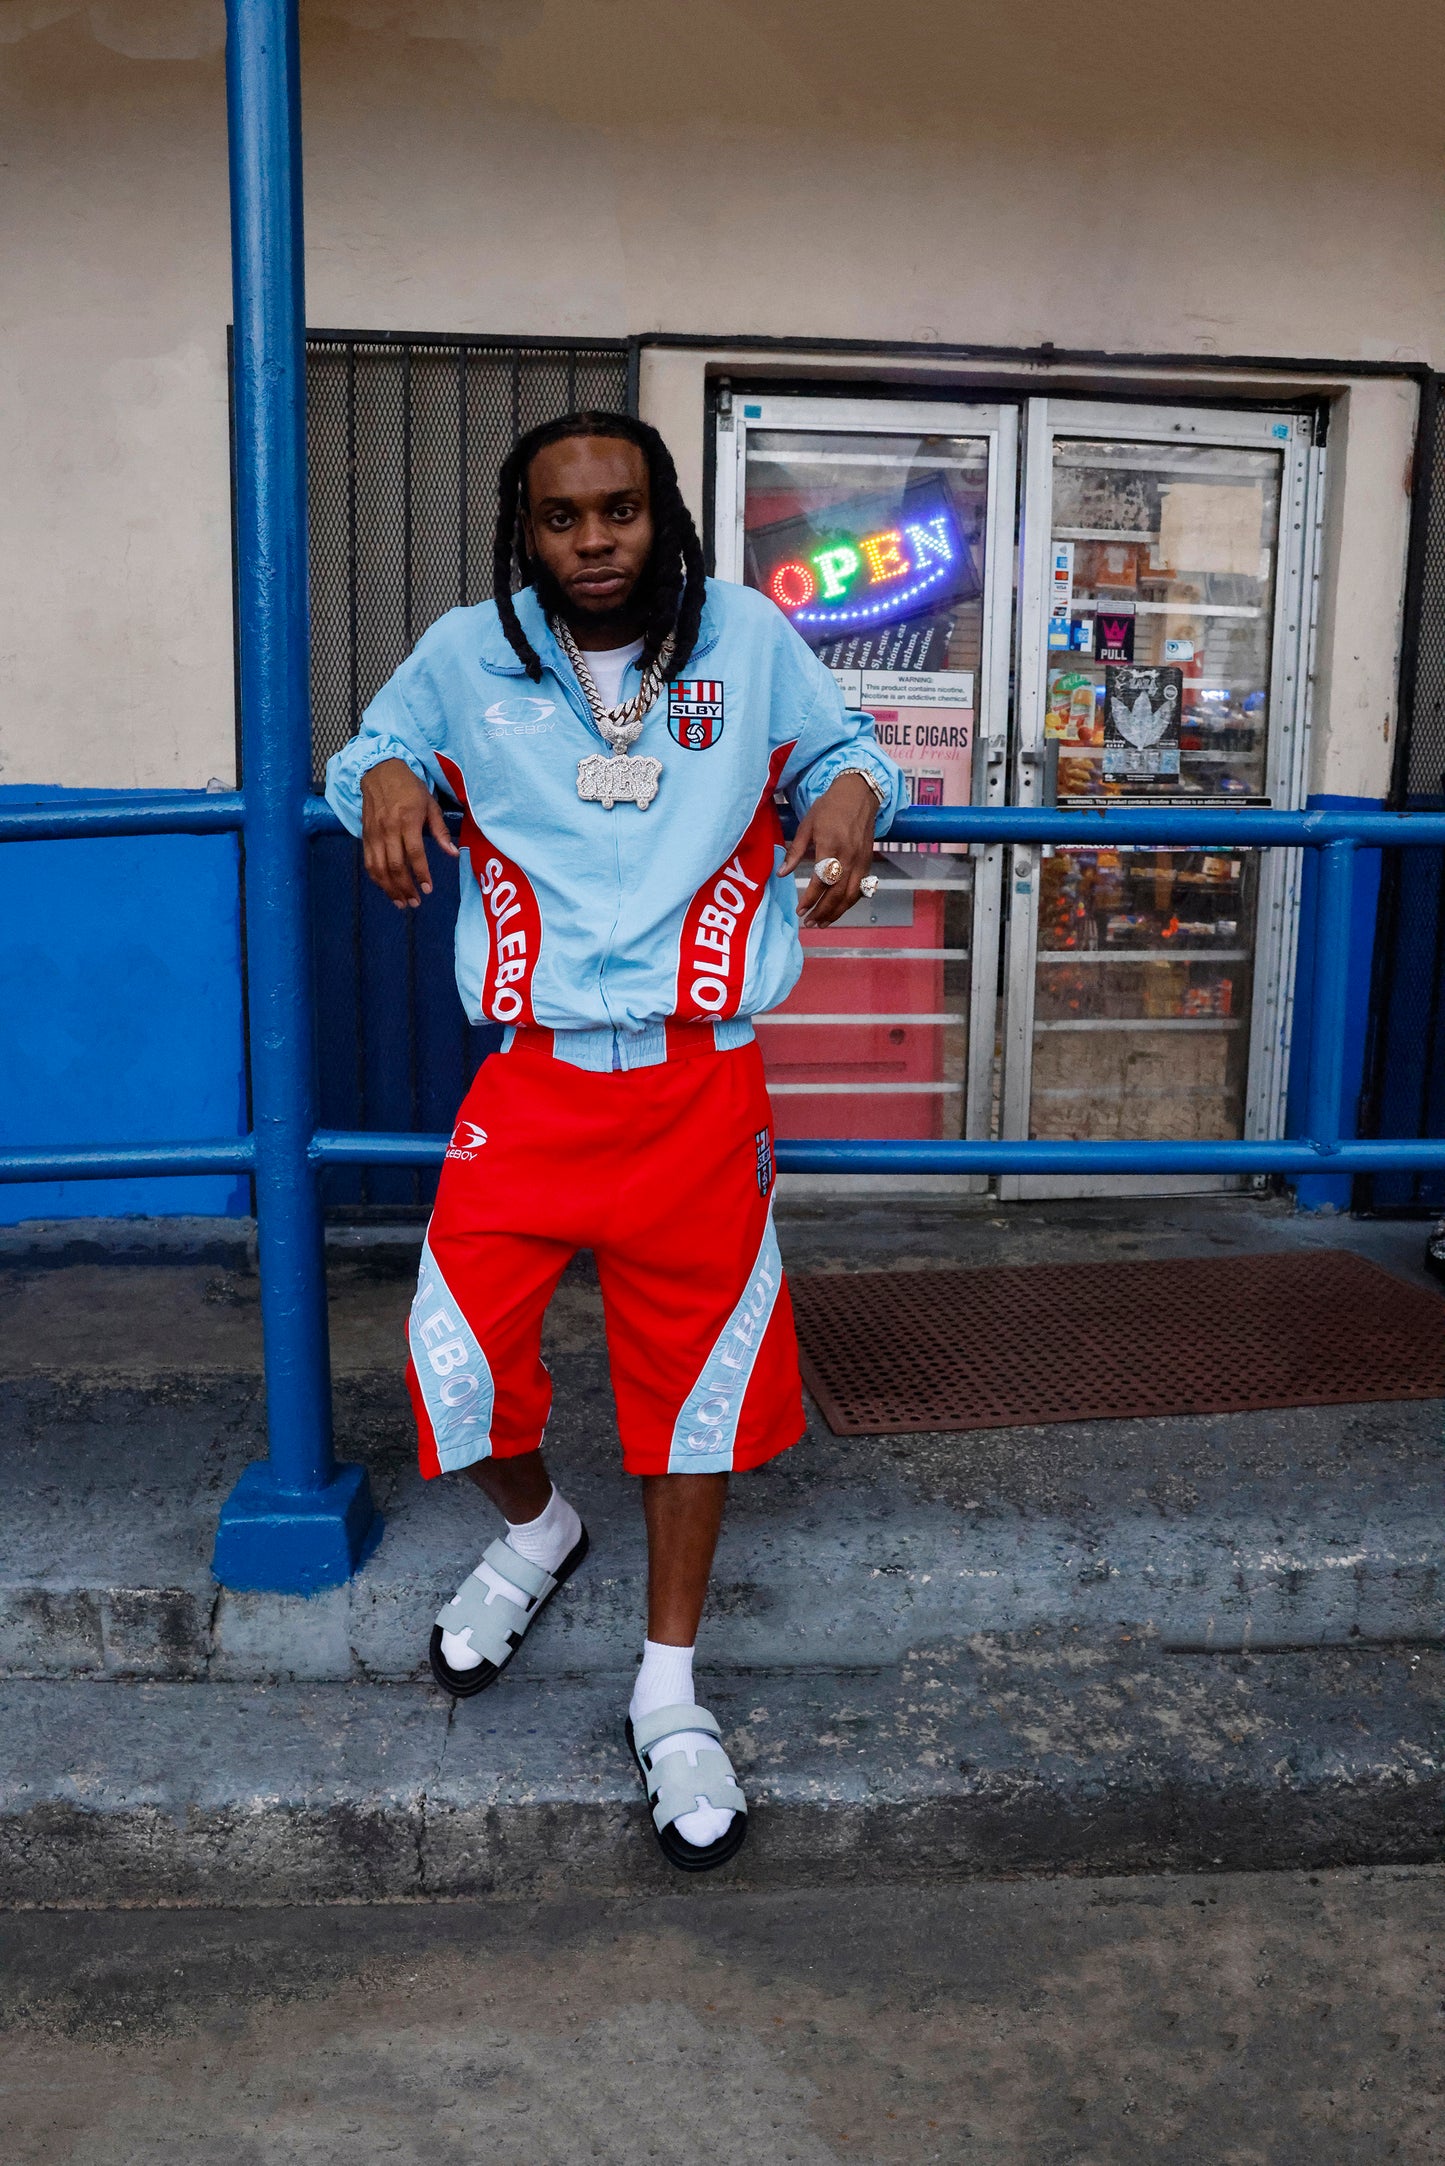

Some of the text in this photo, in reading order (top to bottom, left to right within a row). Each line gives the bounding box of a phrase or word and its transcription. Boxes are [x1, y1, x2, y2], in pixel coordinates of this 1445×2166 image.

[771, 517, 953, 607] OPEN
[877, 629, 891, 656] acute
[901, 631, 920, 669] asthma,
[913, 627, 935, 670] function.
[858, 640, 873, 668] death
[1100, 648, 1128, 661] PULL
[881, 684, 907, 692] product
[898, 676, 934, 684] WARNING:
[671, 703, 721, 717] SLBY
[486, 721, 557, 740] SOLEBOY
[915, 725, 968, 748] CIGARS
[919, 745, 961, 761] Fresh
